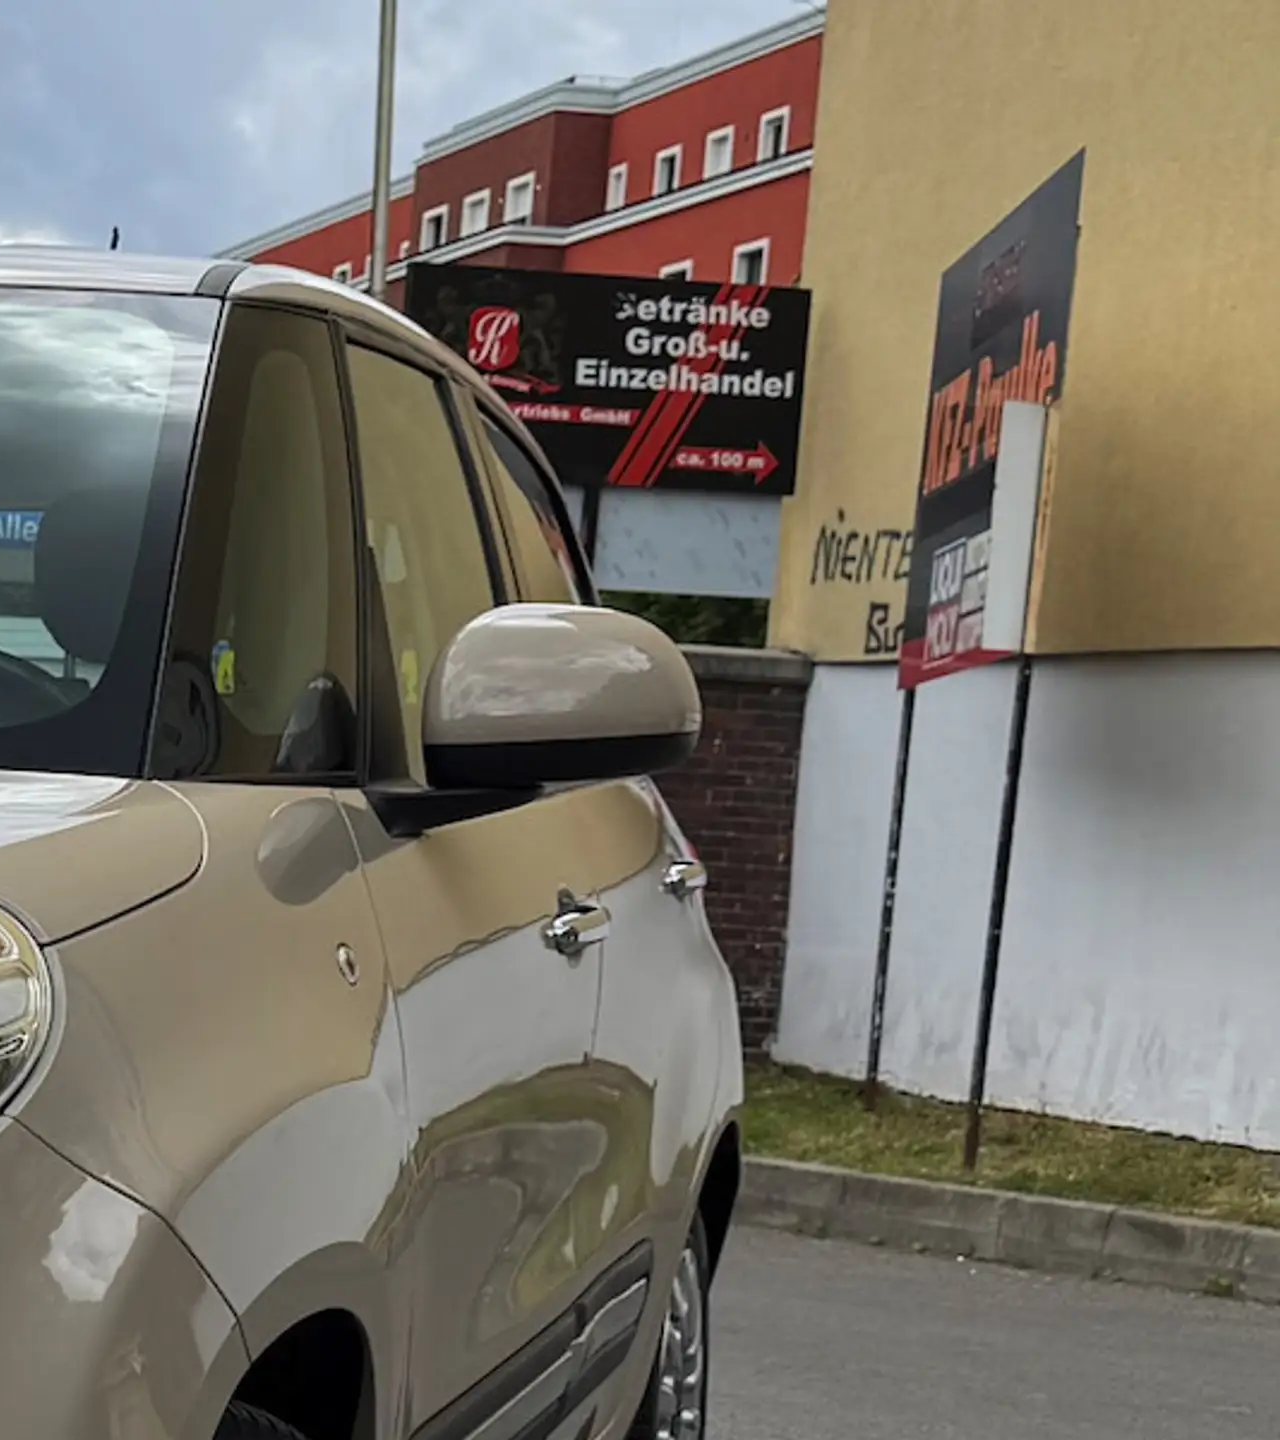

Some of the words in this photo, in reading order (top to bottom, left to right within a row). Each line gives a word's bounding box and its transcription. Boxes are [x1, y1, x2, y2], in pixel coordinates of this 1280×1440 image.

[575, 358, 795, 399] Einzelhandel
[580, 406, 631, 424] GmbH
[676, 452, 705, 467] ca.
[711, 451, 743, 468] 100
